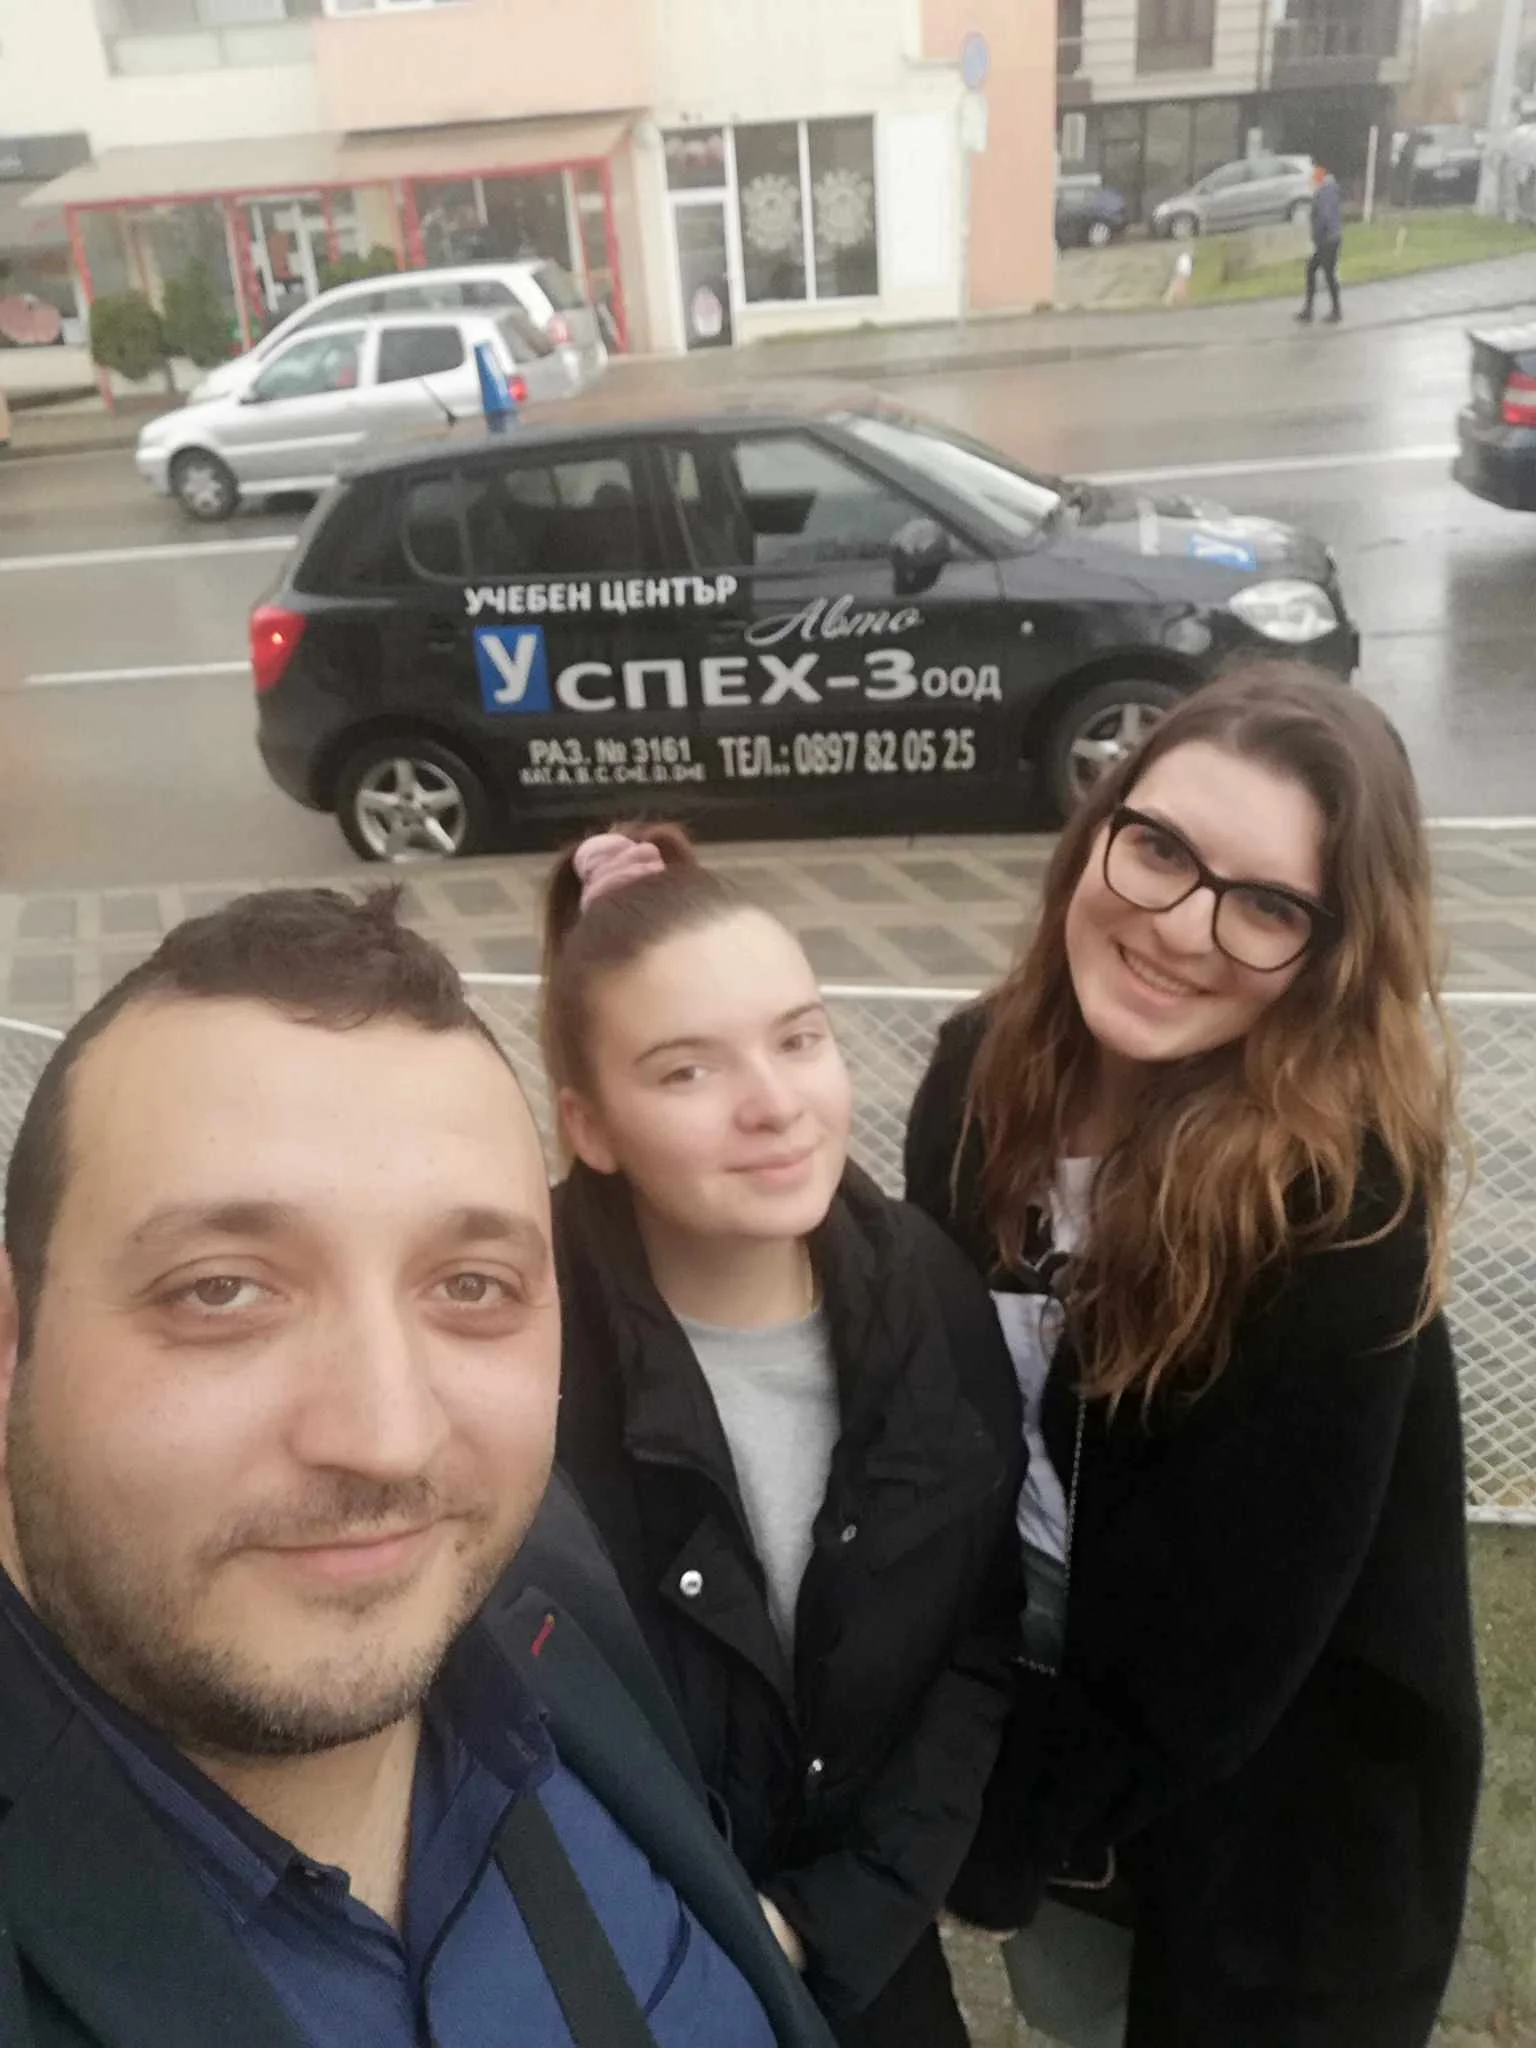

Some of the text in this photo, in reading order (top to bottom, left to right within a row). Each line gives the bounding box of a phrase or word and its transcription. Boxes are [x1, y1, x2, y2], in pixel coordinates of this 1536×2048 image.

[464, 573, 738, 616] УЧЕБЕН ЦЕНТЪР
[630, 736, 692, 764] 3161
[793, 731, 859, 775] 0897
[864, 729, 899, 772] 82
[902, 727, 937, 772] 05
[941, 727, 977, 771] 25
